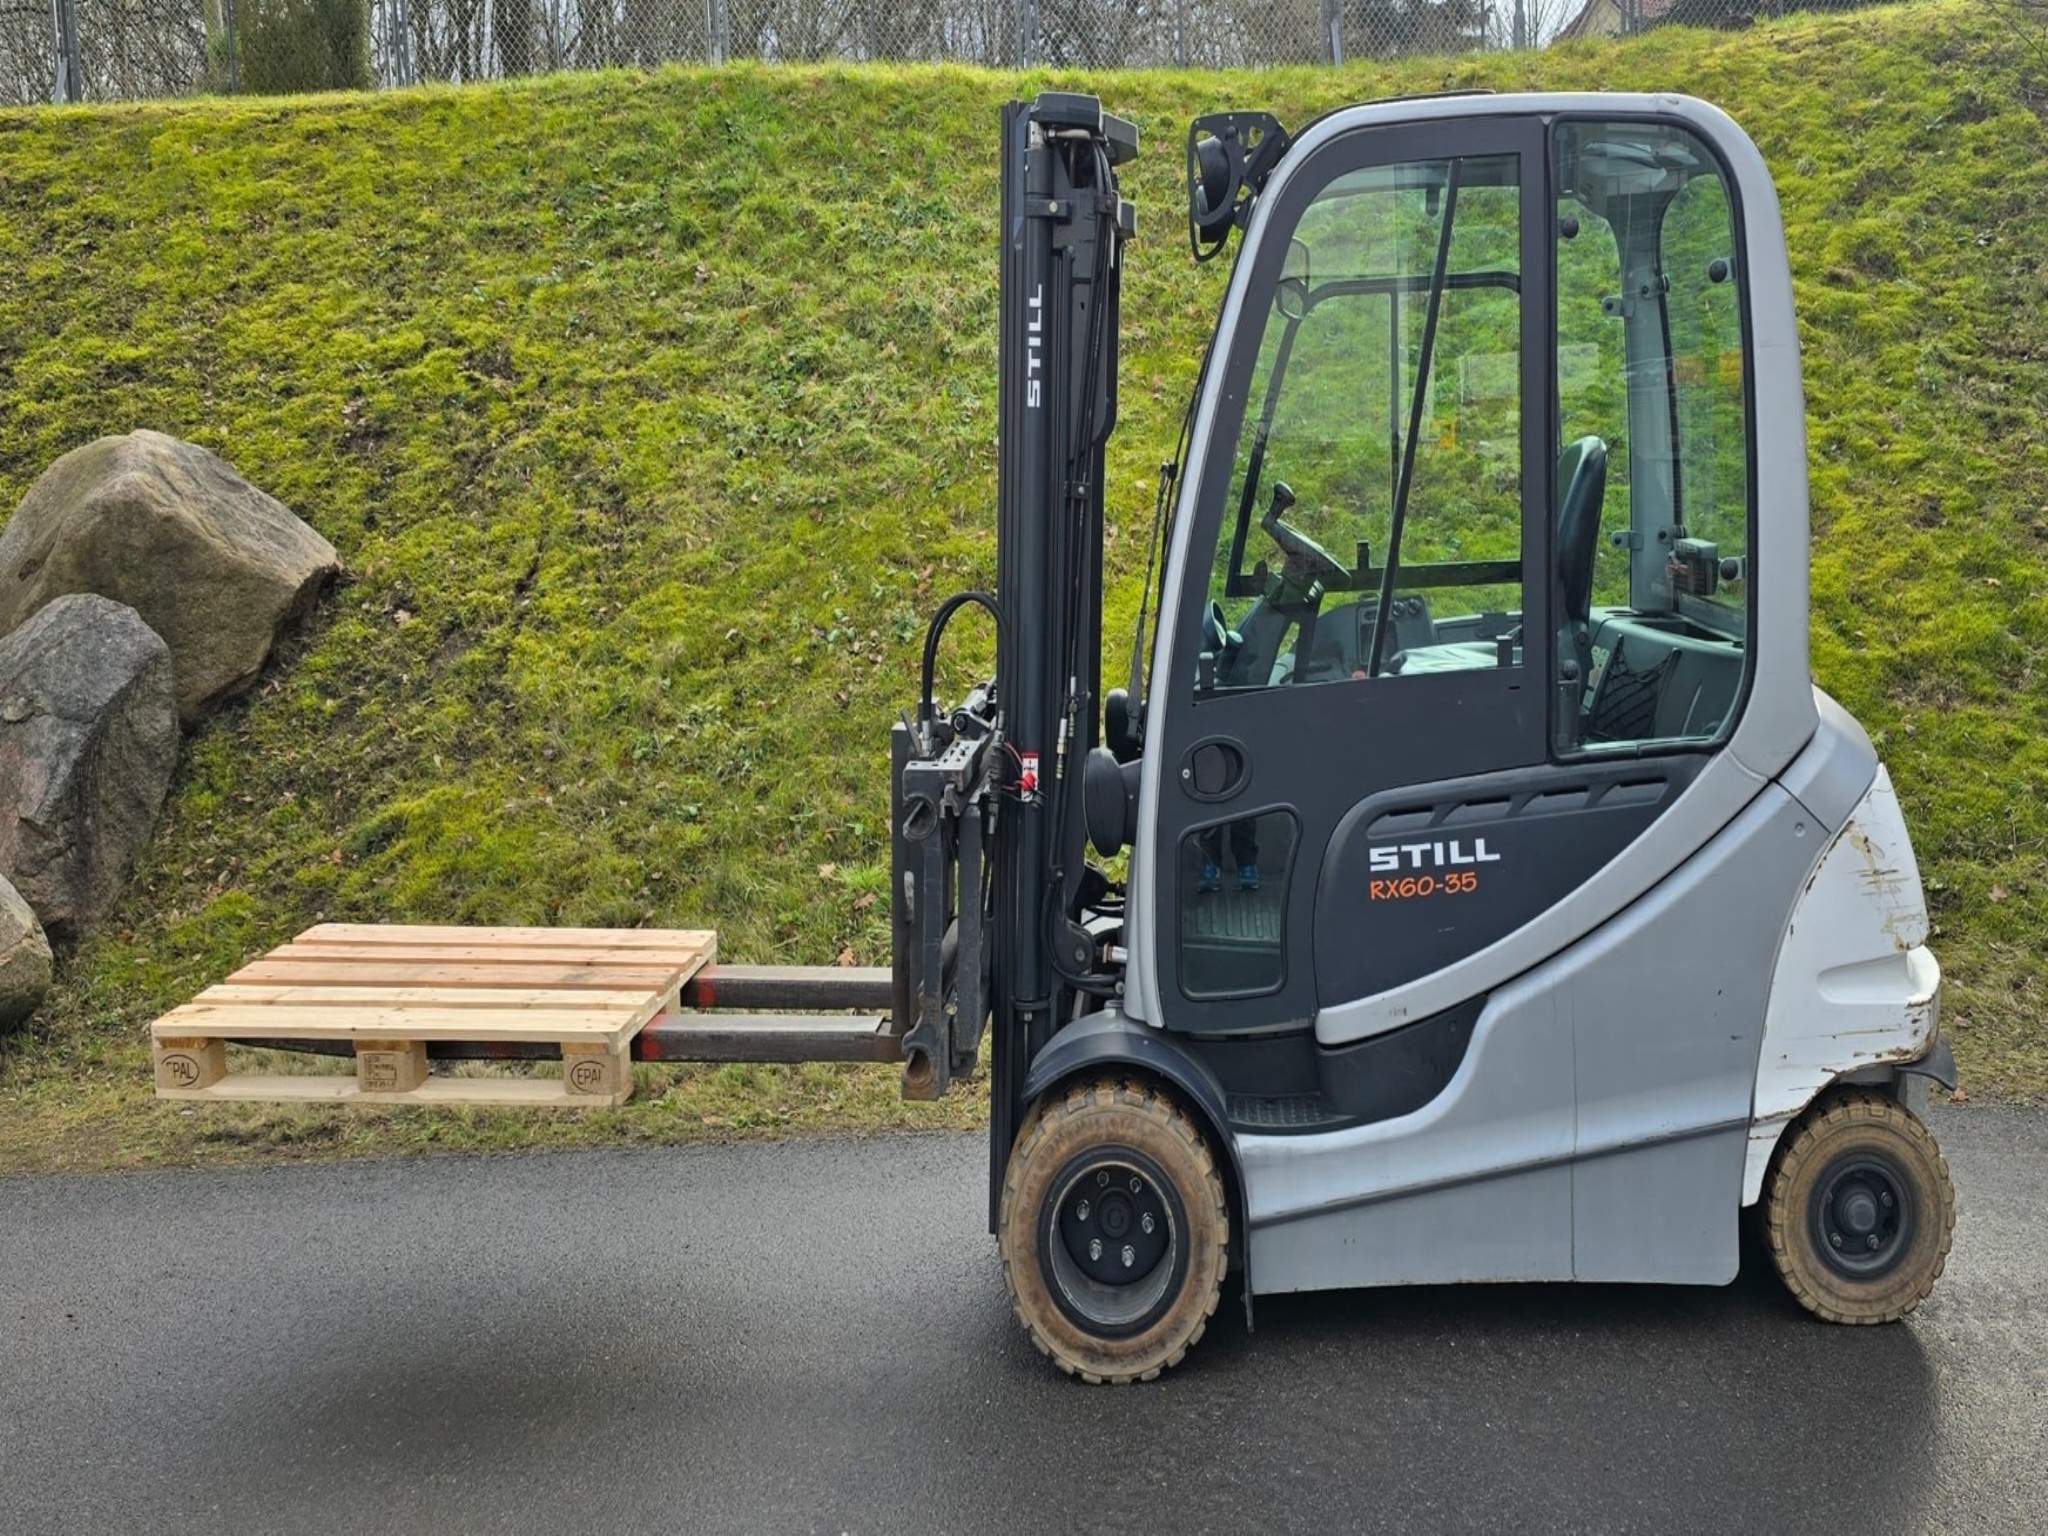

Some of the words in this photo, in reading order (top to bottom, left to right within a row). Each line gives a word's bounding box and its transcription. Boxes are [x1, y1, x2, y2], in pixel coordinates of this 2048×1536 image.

[1027, 284, 1042, 408] STILL
[1369, 838, 1501, 872] STILL
[1369, 871, 1478, 900] RX60-35
